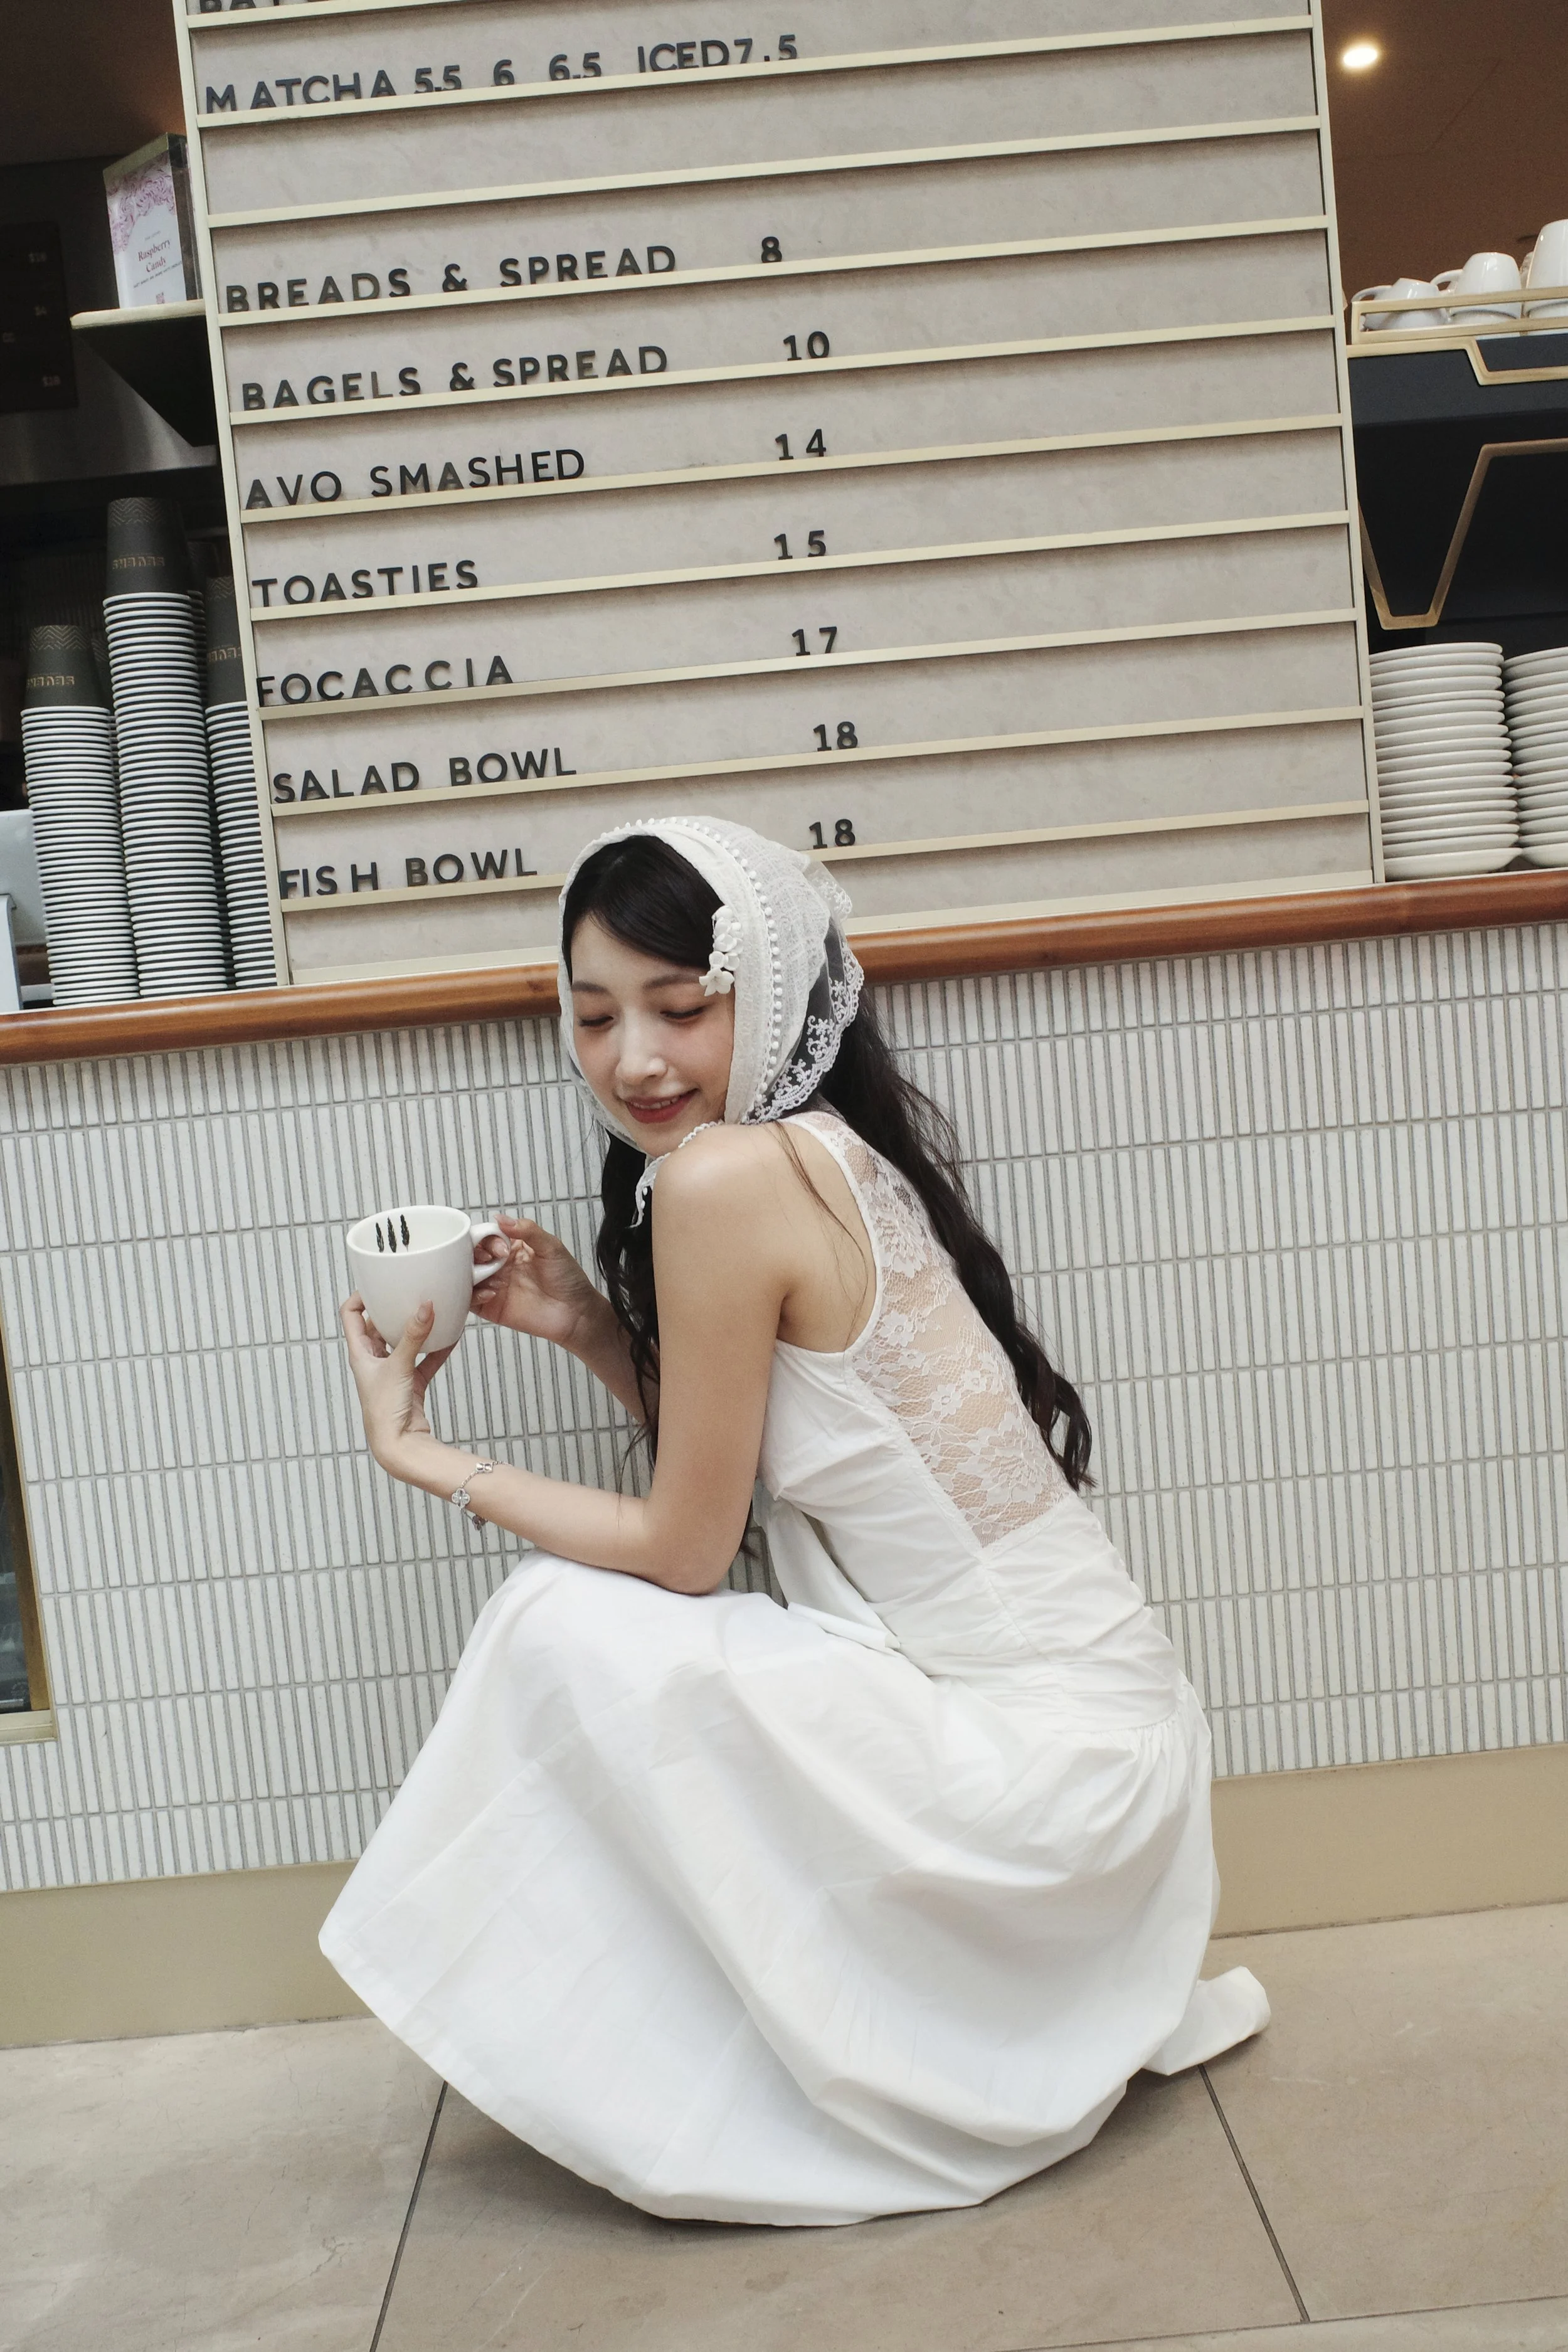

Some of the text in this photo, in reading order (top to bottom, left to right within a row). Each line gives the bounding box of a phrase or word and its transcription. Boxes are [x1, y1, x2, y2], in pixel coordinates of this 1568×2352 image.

[206, 70, 397, 114] MATCHA
[414, 65, 462, 94] 5.5
[493, 59, 516, 87] 6
[549, 51, 602, 82] 6.5
[138, 239, 170, 262] Raspberry
[146, 256, 166, 272] Candy
[226, 236, 783, 314] BREADS & SPREAD 8
[242, 331, 830, 411] BAGELS & SPREAD 10
[245, 428, 827, 511] AVO SMASHED 14
[252, 529, 827, 608] TOASTIES 15
[257, 626, 837, 707] FOCACCIA 17
[273, 721, 858, 804] SALAD BOWL 18
[280, 818, 857, 900] FISH BOWL 18
